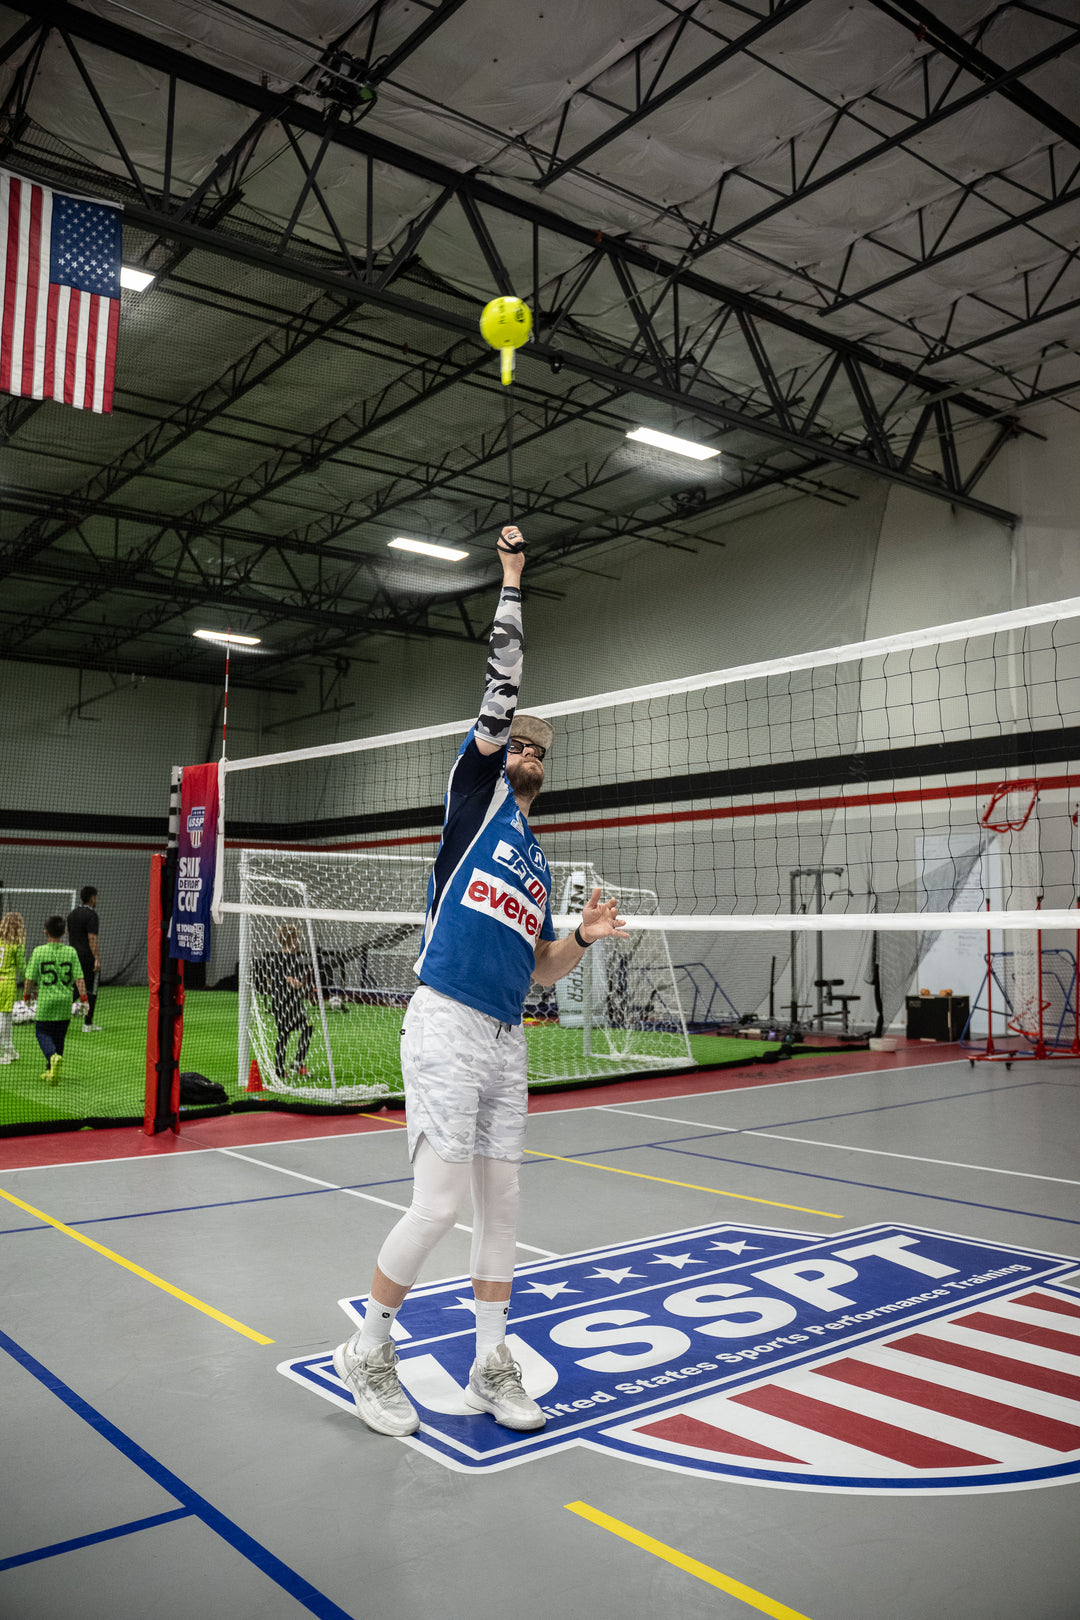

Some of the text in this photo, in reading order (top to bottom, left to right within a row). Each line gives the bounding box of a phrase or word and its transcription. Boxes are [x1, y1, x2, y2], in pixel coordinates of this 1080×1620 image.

[40, 962, 72, 986] 53
[399, 1234, 961, 1416] USSPT
[541, 1263, 1033, 1419] ited States Sports Performance Training
